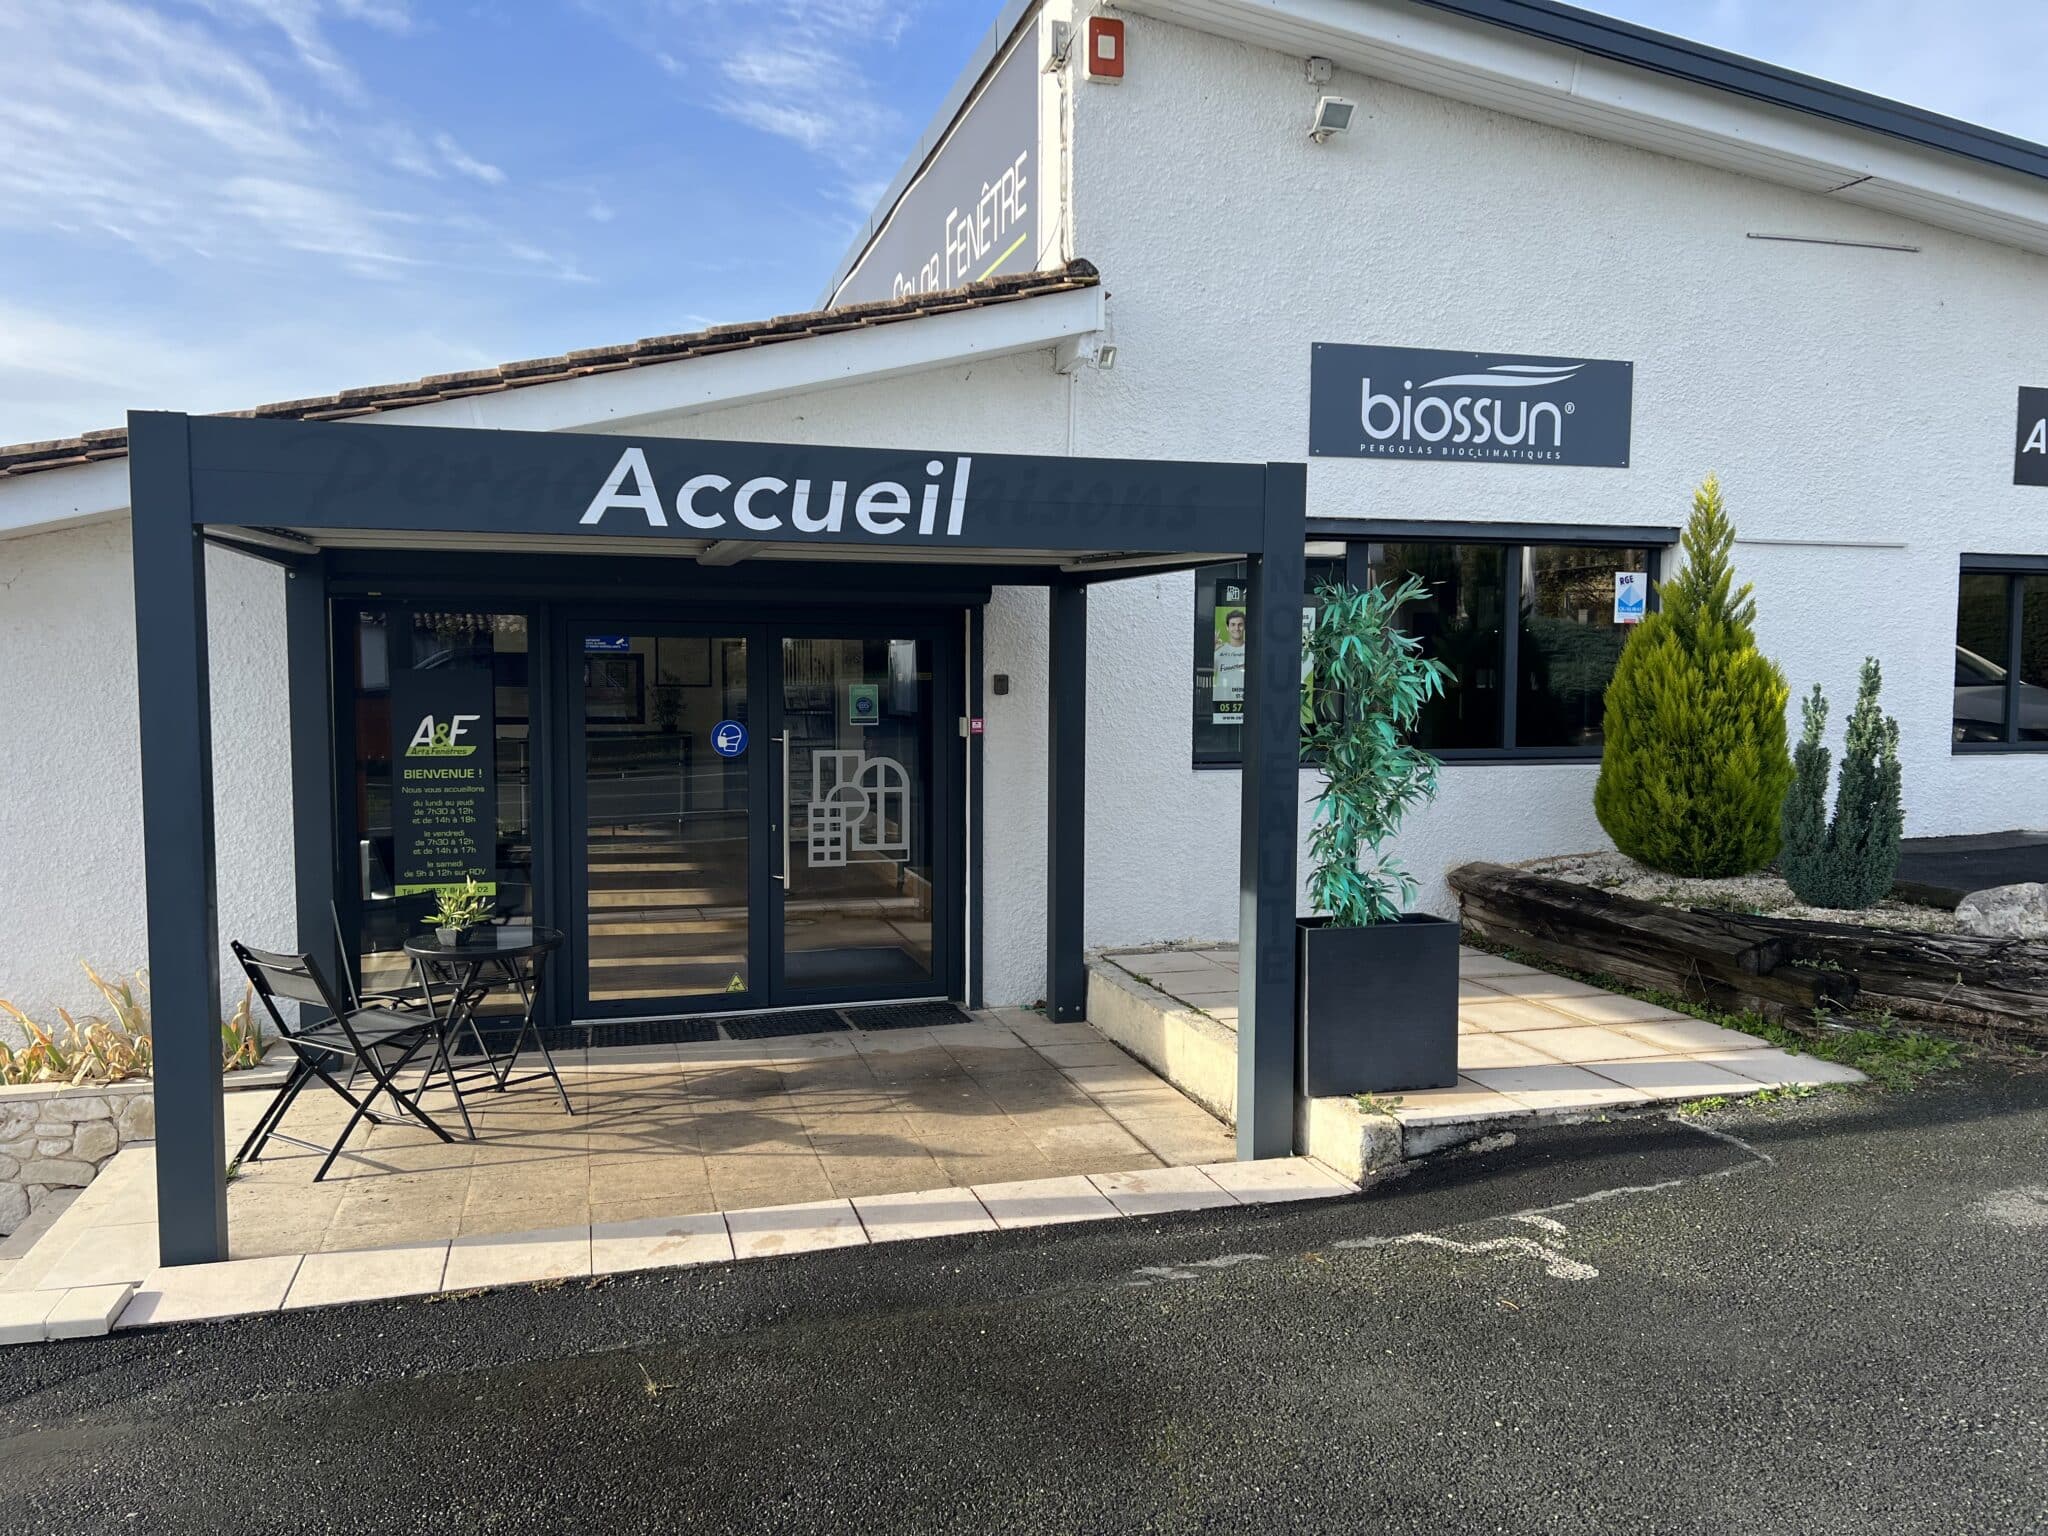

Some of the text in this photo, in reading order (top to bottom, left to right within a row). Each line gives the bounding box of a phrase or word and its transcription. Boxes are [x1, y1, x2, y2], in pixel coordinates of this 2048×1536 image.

[1359, 443, 1562, 461] PERGOLAS BIOCLIMATIQUES
[578, 446, 972, 537] Accueil
[1619, 575, 1634, 586] RGE
[1219, 703, 1243, 712] 05 57
[403, 769, 475, 779] BIENVENUE
[401, 786, 422, 794] Nous
[444, 785, 486, 793] accueillons
[425, 799, 443, 807] lundi
[456, 799, 475, 807] jeudi
[458, 807, 474, 815] 12h
[432, 829, 465, 837] vendredi
[426, 838, 449, 846] 7h30
[458, 837, 474, 845] 12h
[436, 847, 451, 855] 14h
[461, 846, 477, 854] 17h
[436, 859, 463, 867] samedi
[404, 870, 414, 878] de
[416, 869, 427, 877] 9h
[437, 868, 452, 876] 12h
[468, 867, 486, 876] RDV
